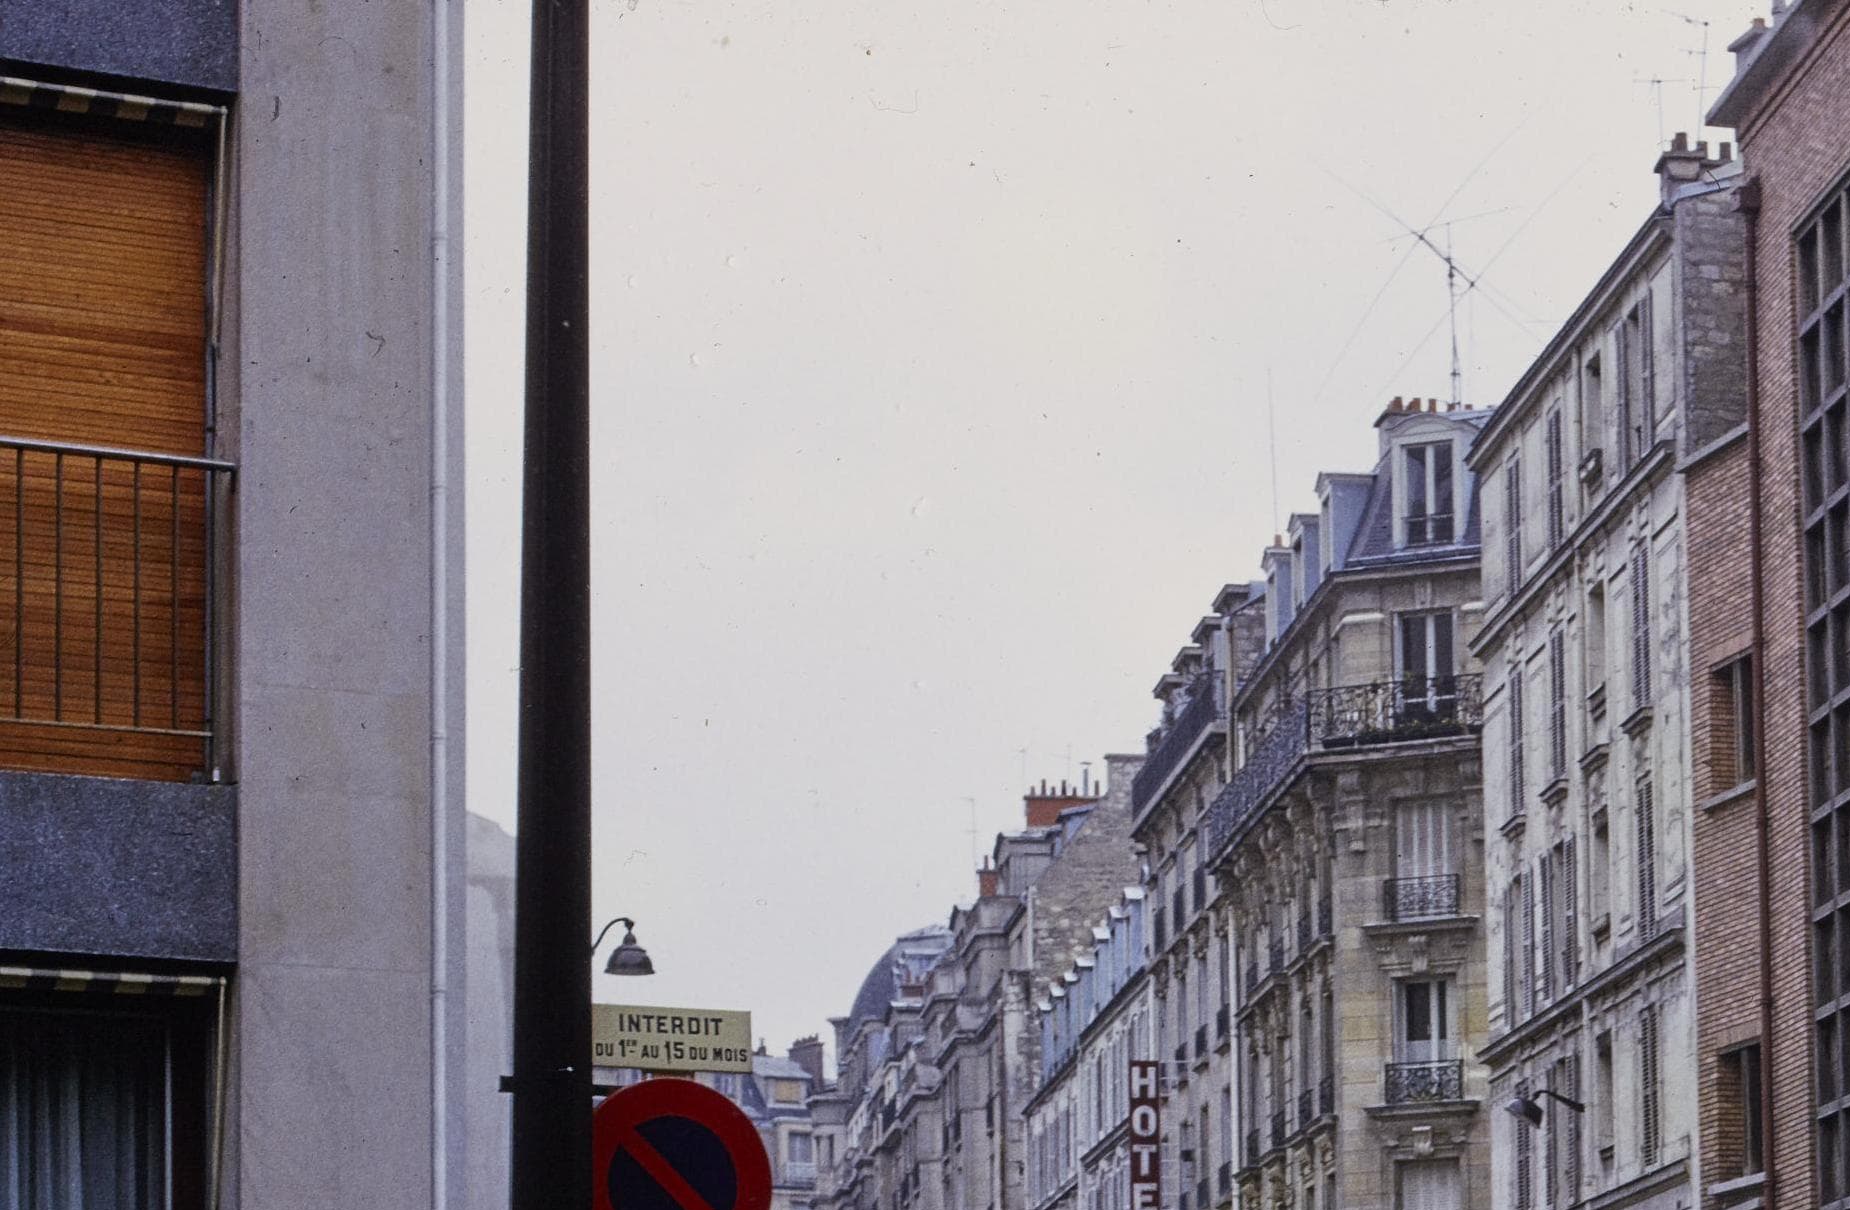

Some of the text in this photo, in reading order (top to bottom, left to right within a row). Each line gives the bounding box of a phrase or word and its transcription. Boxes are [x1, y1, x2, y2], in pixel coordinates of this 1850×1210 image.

[618, 1013, 723, 1036] INTERDIT
[595, 1042, 614, 1057] DU
[641, 1044, 659, 1059] AU
[664, 1041, 684, 1064] 15
[689, 1046, 707, 1061] DU
[712, 1047, 748, 1063] MOIS
